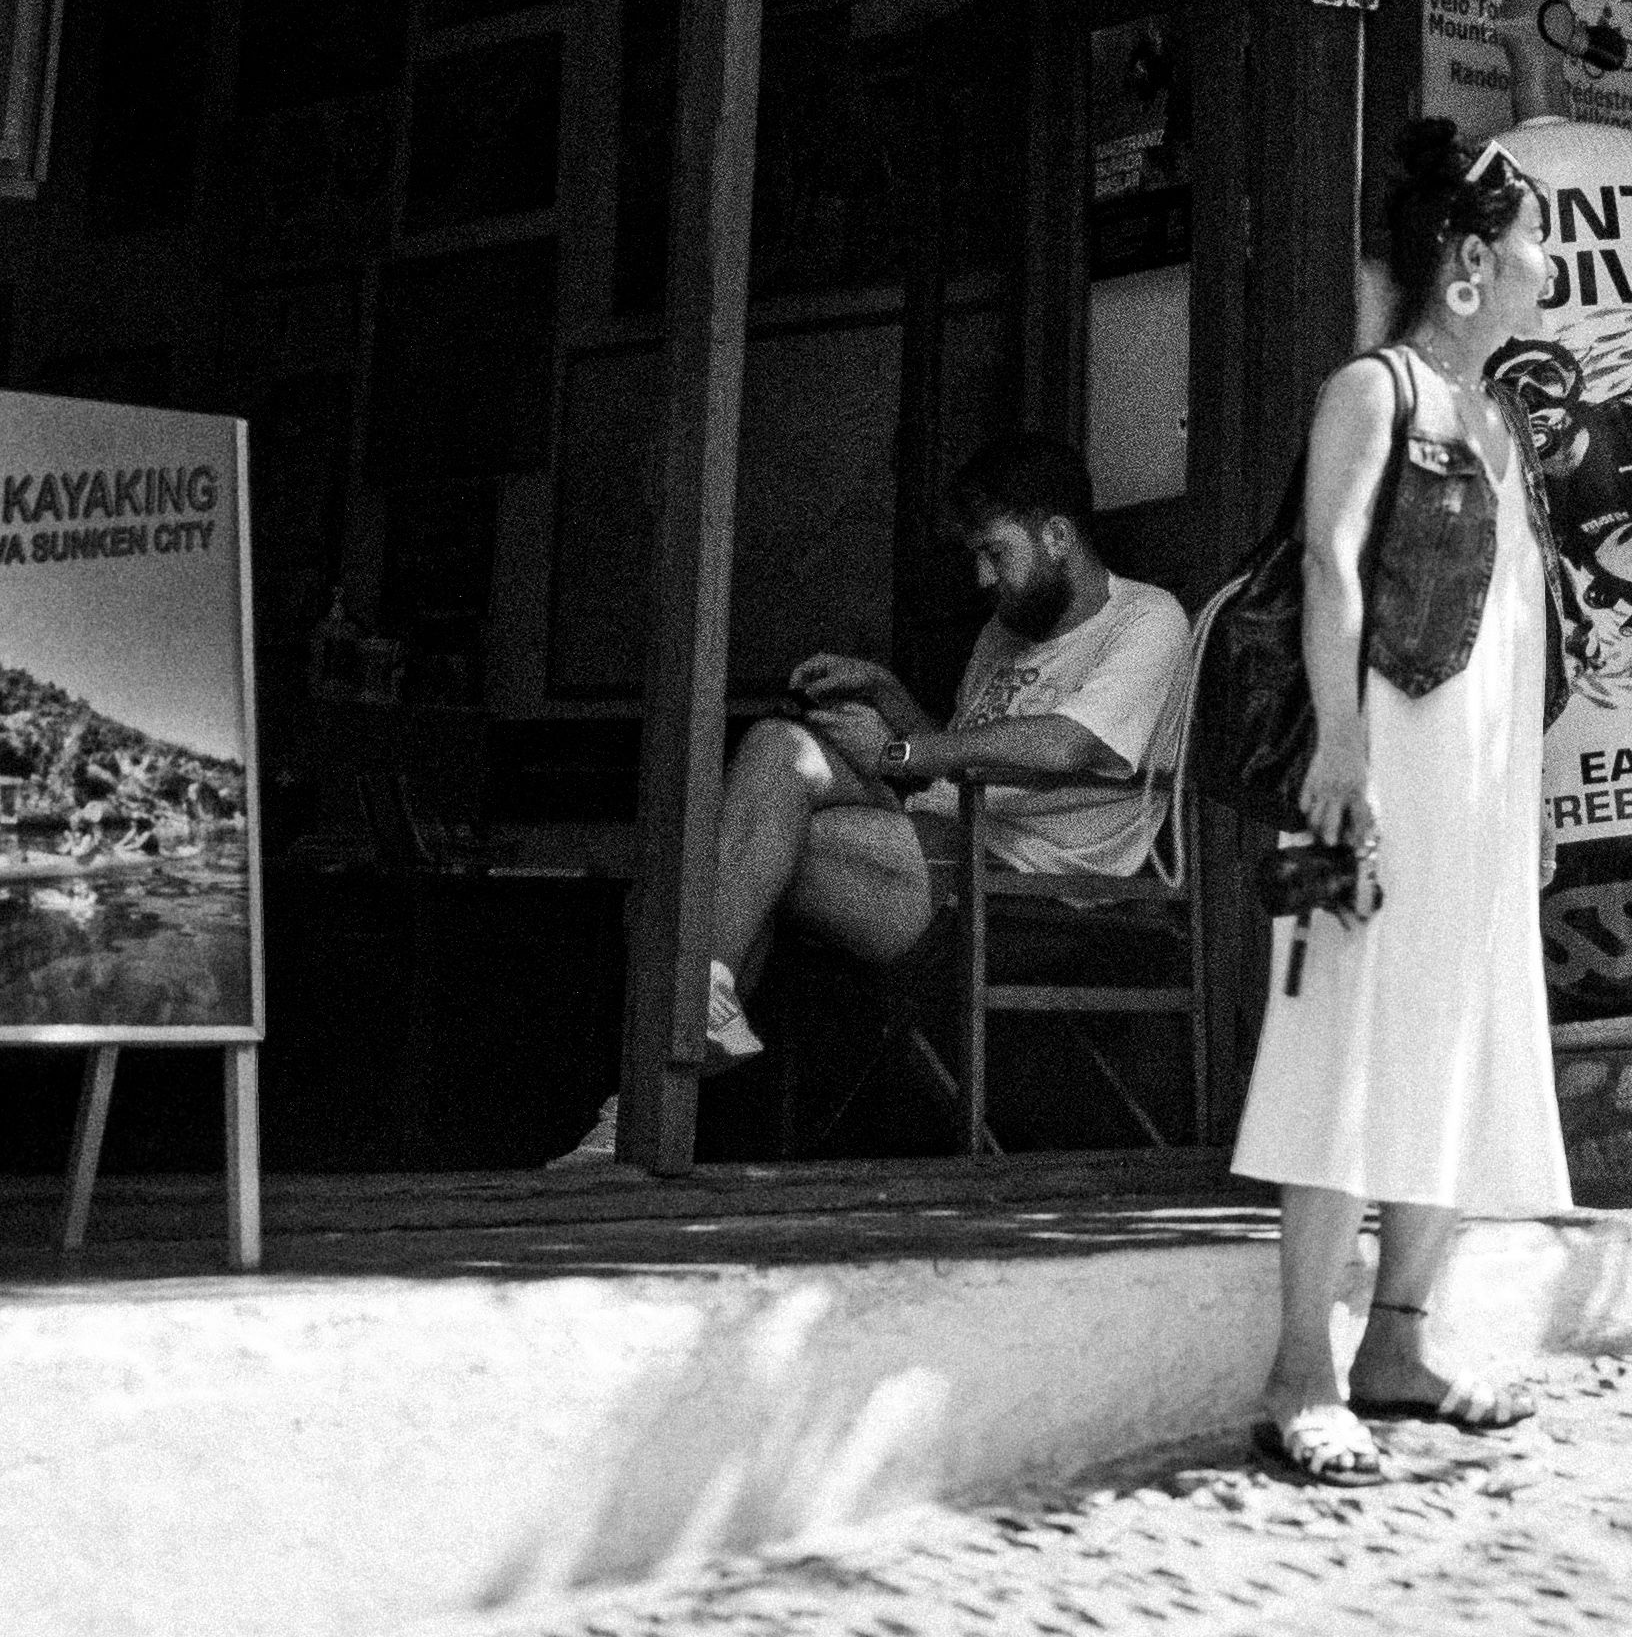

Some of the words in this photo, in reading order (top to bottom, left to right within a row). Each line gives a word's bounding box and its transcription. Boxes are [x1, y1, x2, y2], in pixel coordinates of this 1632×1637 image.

[2, 464, 219, 524] KAYAKING
[30, 524, 149, 564] SUNKEN
[152, 519, 215, 555] CITY
